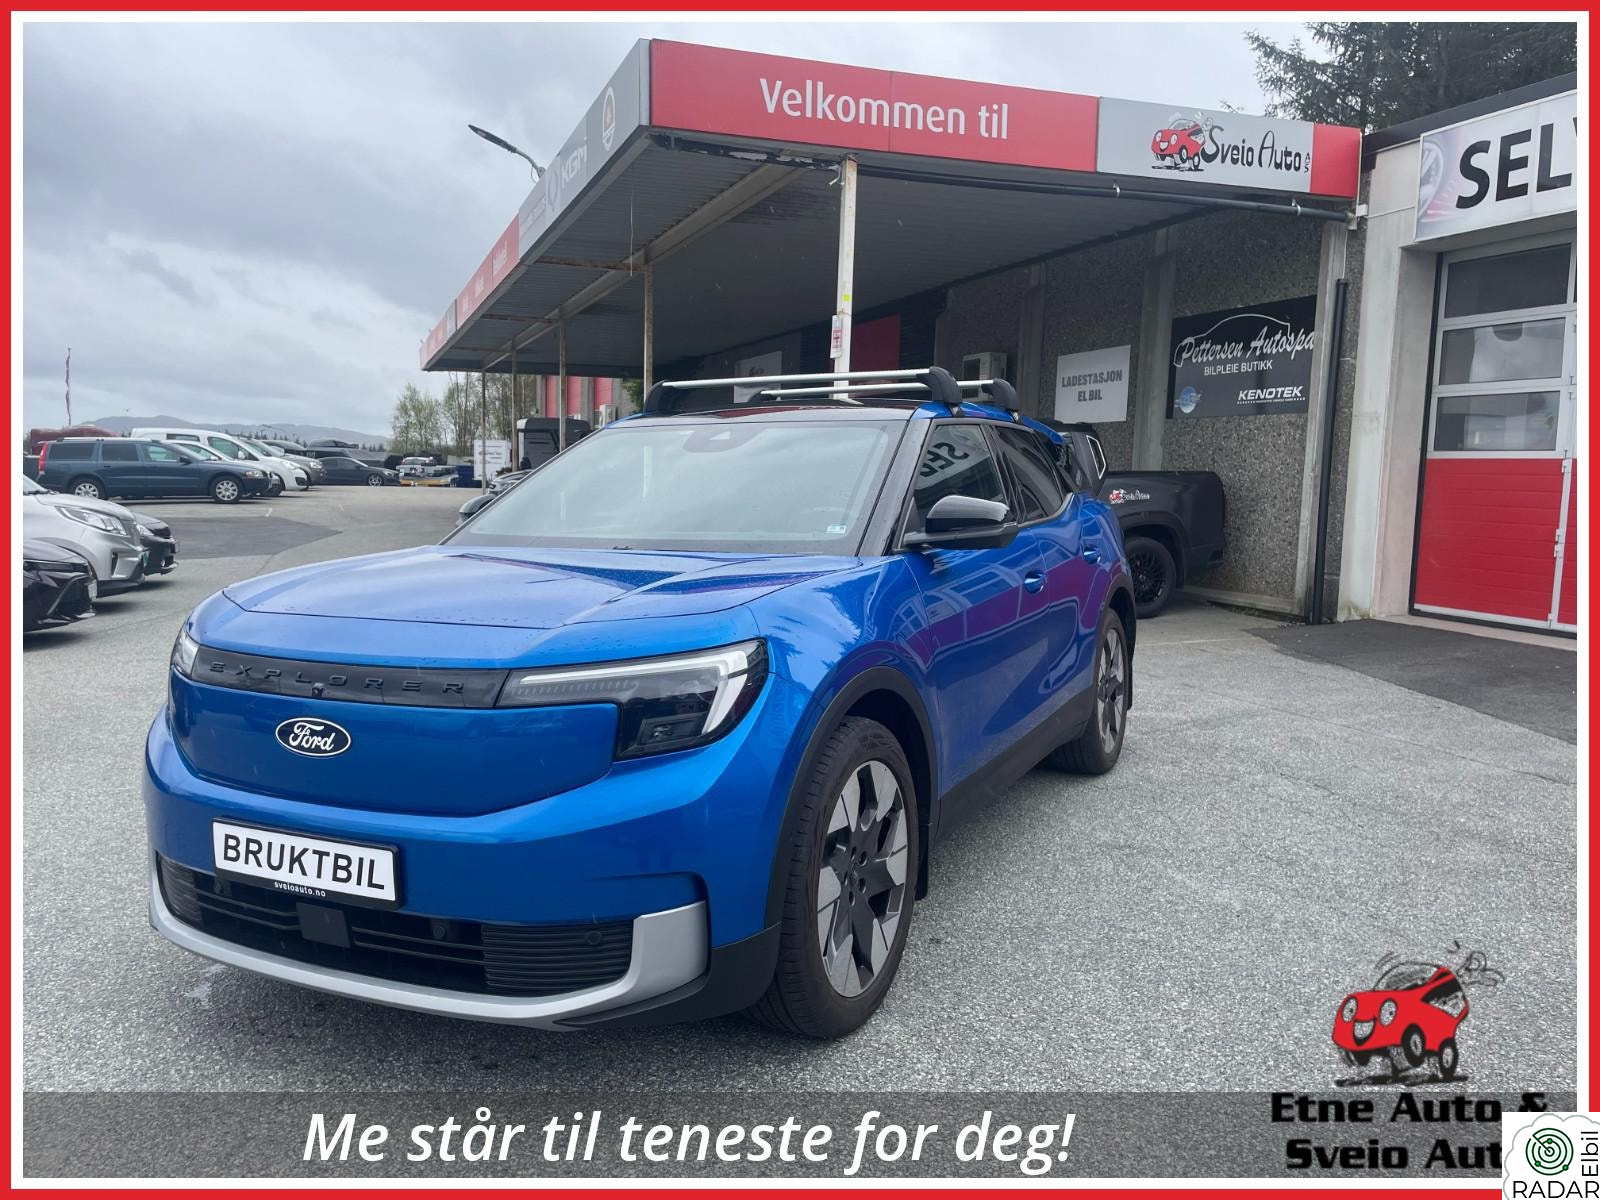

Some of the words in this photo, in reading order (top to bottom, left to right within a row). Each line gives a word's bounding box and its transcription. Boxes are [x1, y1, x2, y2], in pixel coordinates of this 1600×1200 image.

[759, 78, 966, 135] Velkommen
[978, 103, 1009, 140] til
[1200, 125, 1255, 167] Sveio
[1257, 130, 1302, 172] Auto
[1456, 117, 1578, 209] SEL
[1181, 337, 1244, 363] Pettersen
[1246, 326, 1315, 360] Autospa
[1062, 369, 1123, 388] LADESTASJON
[1204, 363, 1239, 376] BILPLEIE
[1241, 360, 1273, 373] BUTIKK
[1077, 390, 1088, 402] EL
[1089, 389, 1103, 401] BIL
[1238, 386, 1303, 401] KENOTEK
[208, 661, 466, 694] EXPLORER
[288, 721, 335, 751] Ford
[223, 833, 385, 891] BRUKTBIL
[274, 881, 326, 898] sveioauto.no
